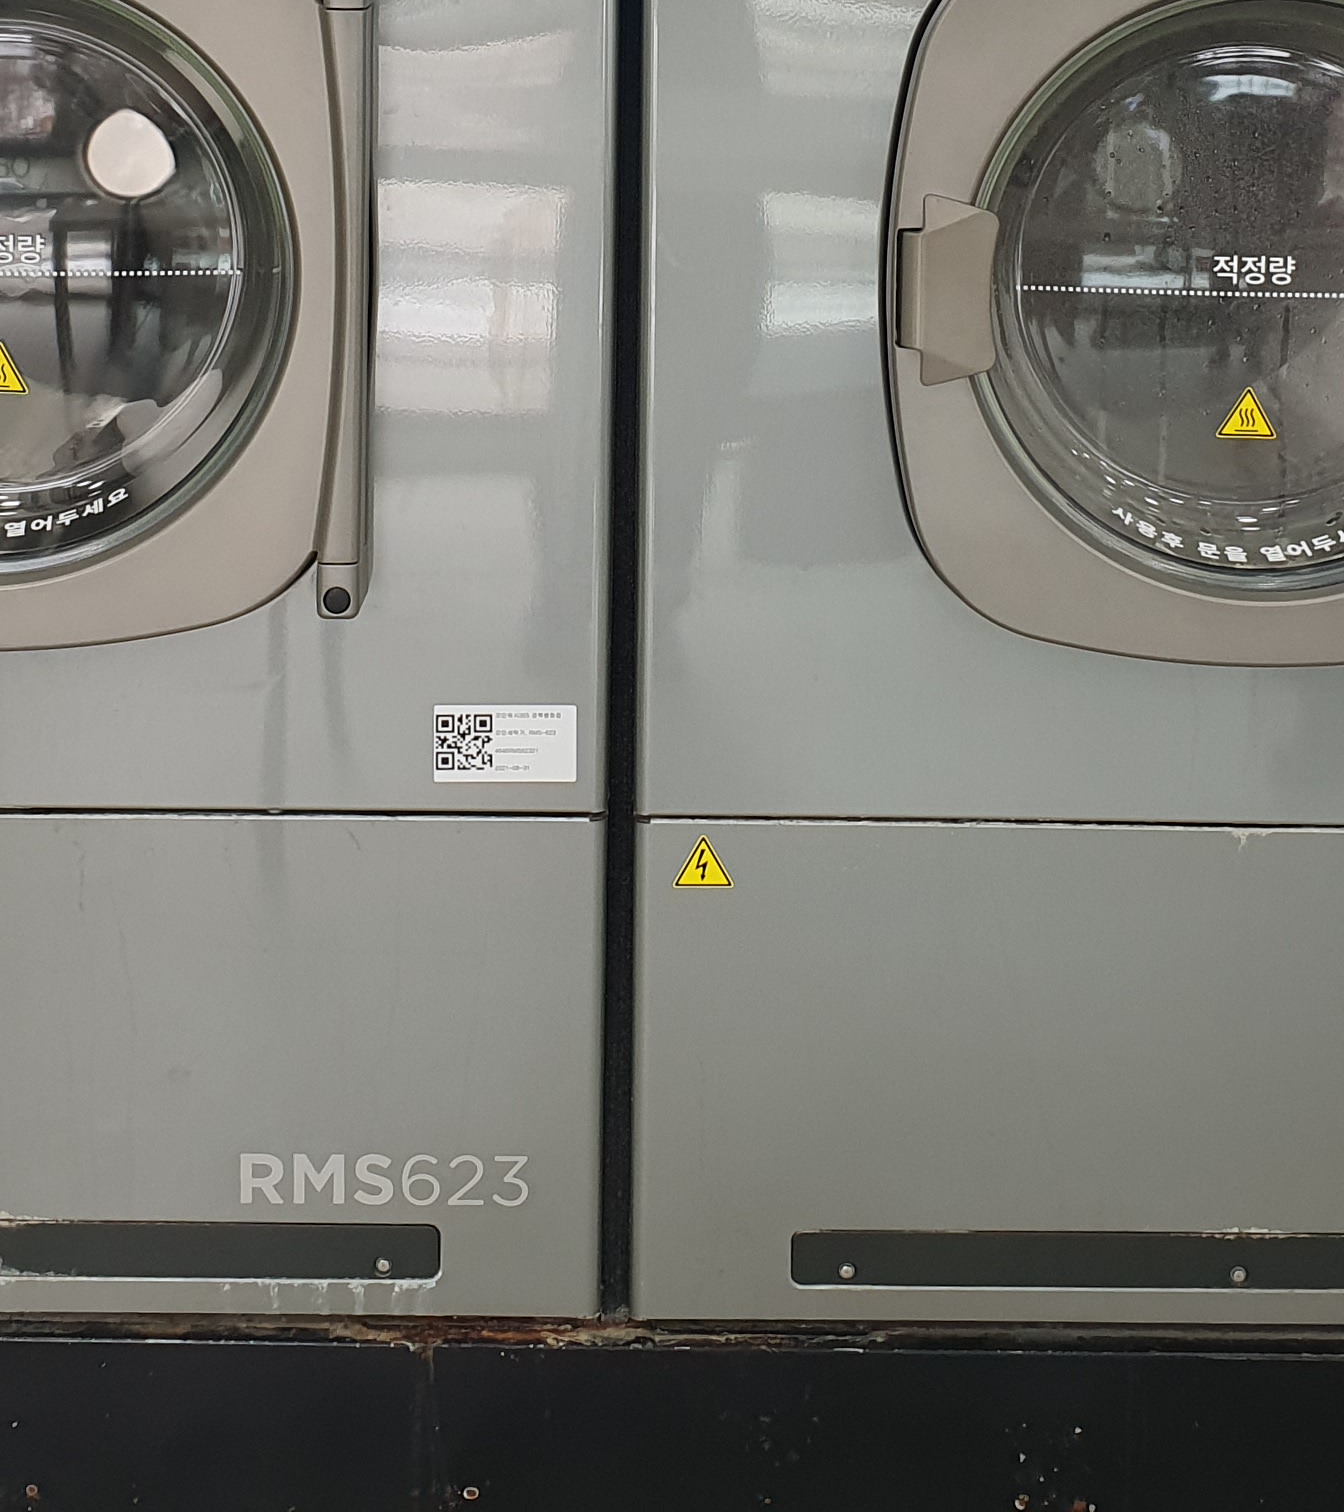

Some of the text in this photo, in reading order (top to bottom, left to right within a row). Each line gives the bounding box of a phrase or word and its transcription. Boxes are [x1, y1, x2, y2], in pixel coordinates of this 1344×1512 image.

[1212, 255, 1296, 285] 적정량
[5, 488, 128, 537] 열어두세요
[1112, 506, 1184, 549] 사용후
[1197, 541, 1248, 563] 문을
[240, 1153, 529, 1208] RMS623
